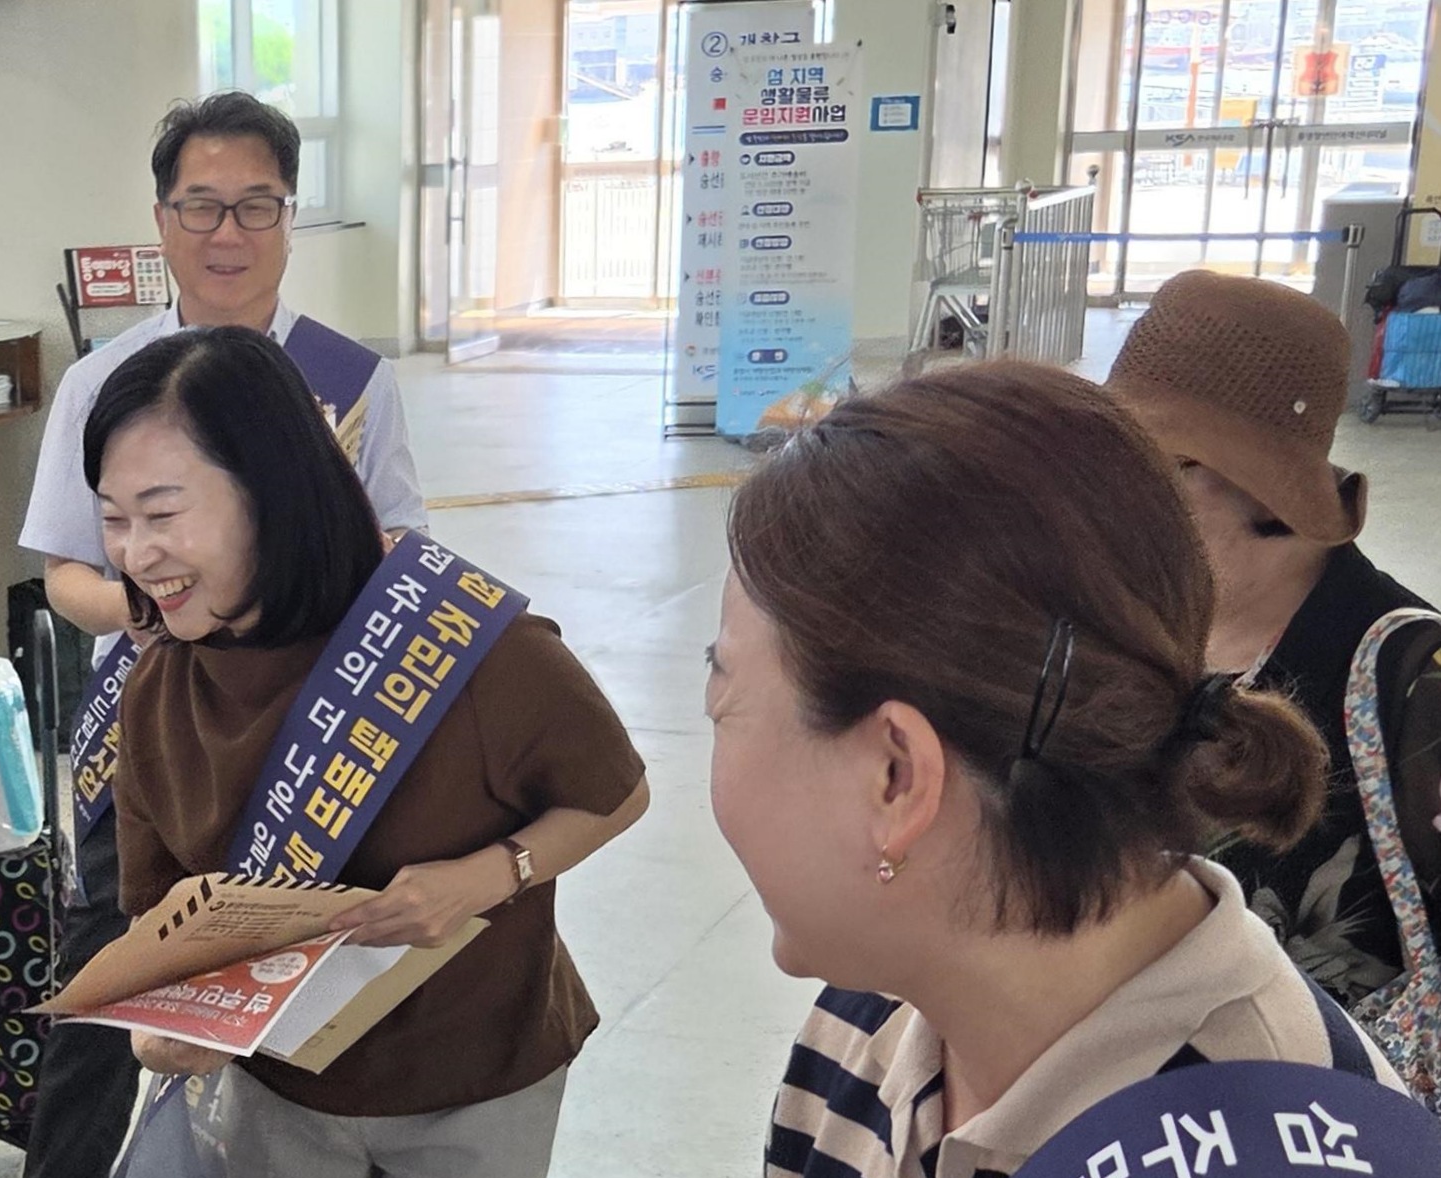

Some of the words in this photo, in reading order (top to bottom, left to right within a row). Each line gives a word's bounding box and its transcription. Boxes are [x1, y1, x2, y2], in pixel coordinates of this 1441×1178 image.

[761, 86, 830, 106] 생활물류
[790, 66, 824, 85] 지역
[742, 104, 846, 126] 운임지원사업
[418, 543, 456, 576] 섬
[457, 571, 507, 609] 섬
[334, 573, 428, 697] 주민의
[373, 599, 481, 724] 주민의
[308, 696, 346, 744] 더
[266, 743, 317, 823] 나은
[303, 716, 400, 840] 택배비
[1274, 1102, 1374, 1174] 섬
